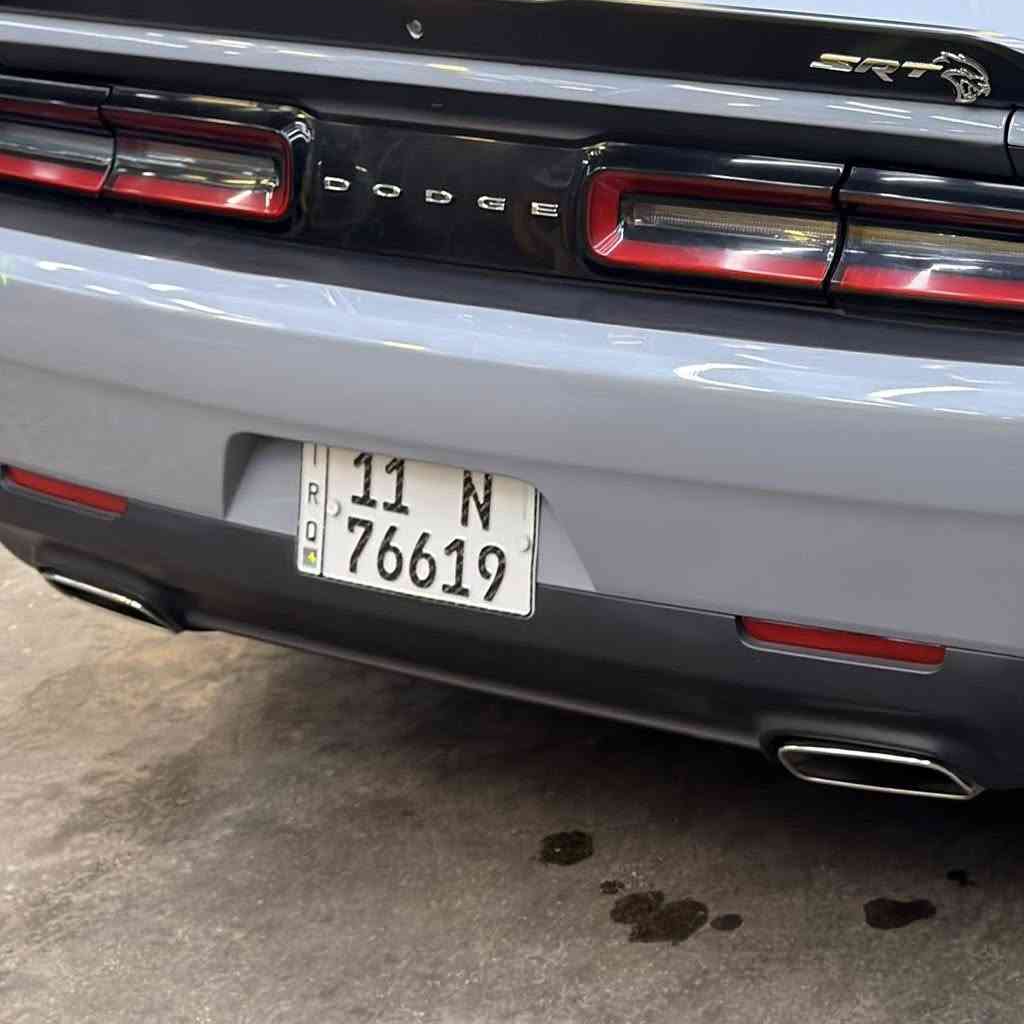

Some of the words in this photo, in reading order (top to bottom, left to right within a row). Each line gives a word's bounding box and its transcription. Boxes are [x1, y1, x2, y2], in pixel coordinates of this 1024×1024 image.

[809, 53, 944, 82] SRT
[324, 176, 559, 217] DODGE
[352, 452, 410, 515] 11
[460, 470, 494, 531] N
[347, 516, 507, 602] 76619
